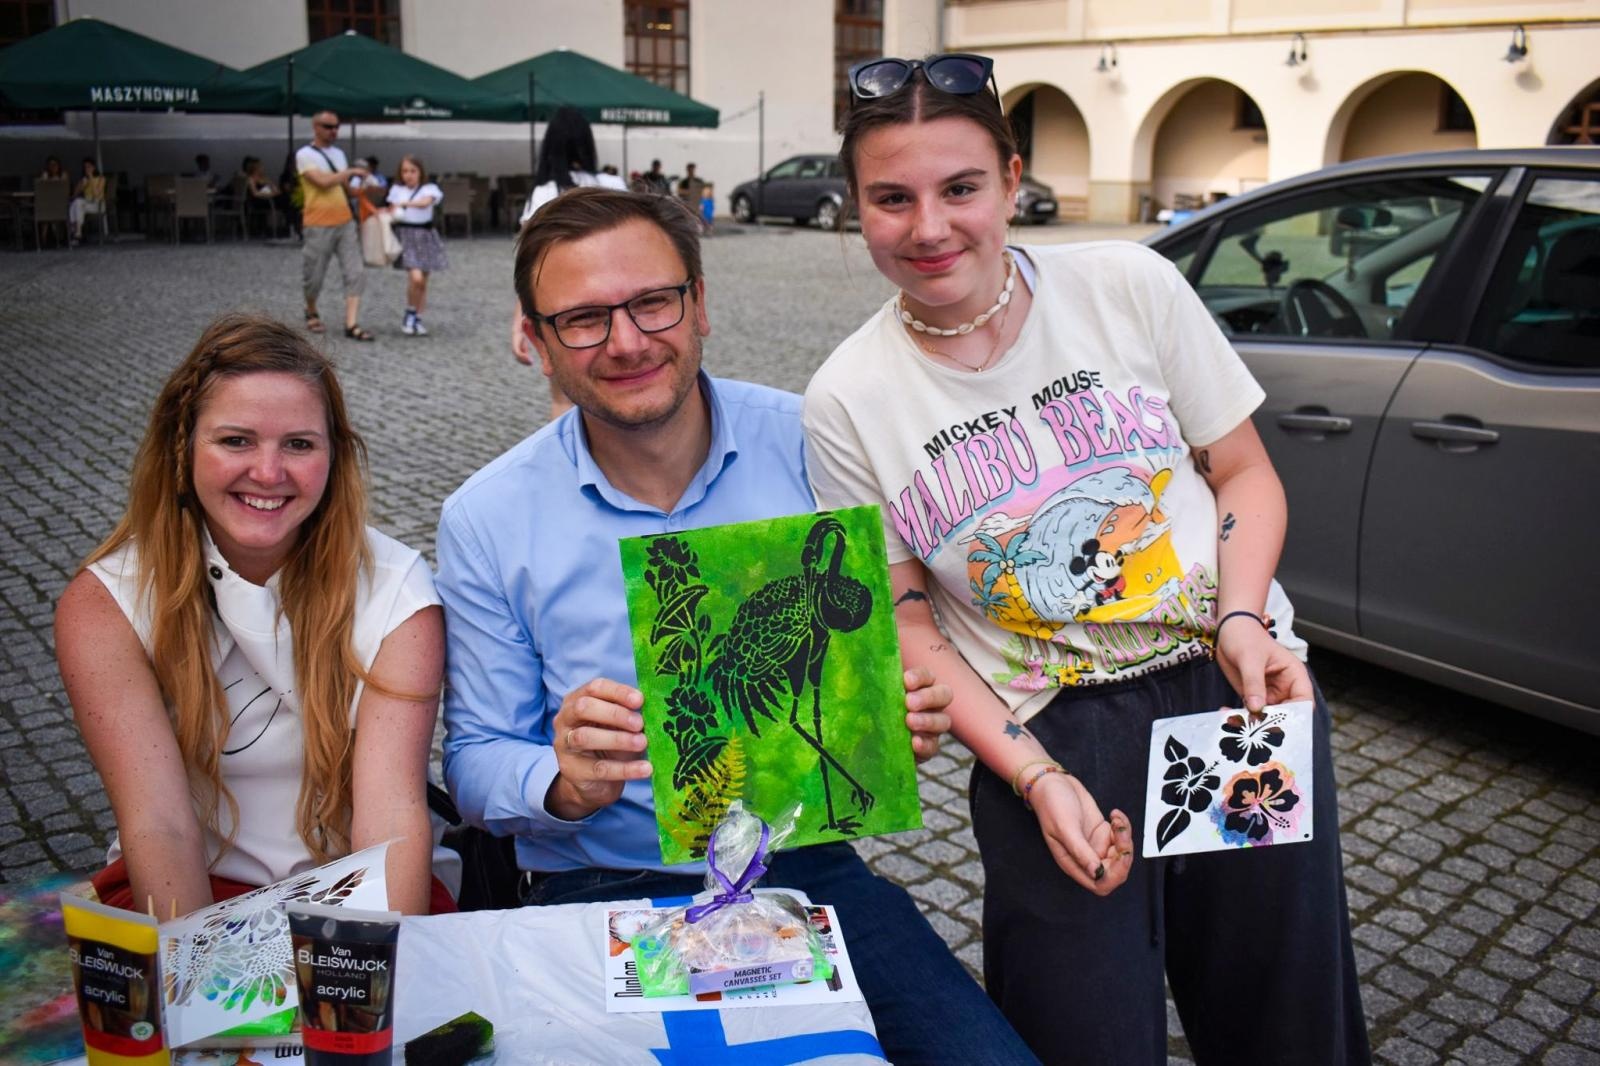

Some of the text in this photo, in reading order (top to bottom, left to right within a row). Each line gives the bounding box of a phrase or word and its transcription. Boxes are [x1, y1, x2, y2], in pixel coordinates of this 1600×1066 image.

[923, 369, 1104, 461] MICKEY MOUSE
[889, 416, 1039, 562] MALIBU
[96, 946, 115, 960] Van
[330, 945, 352, 957] Van
[69, 948, 144, 980] BLEISWIJCK
[298, 949, 387, 972] BLEISWIJCK
[316, 969, 367, 980] HOLLAND
[723, 972, 782, 988] CANVASSES SET
[734, 966, 772, 978] MAGNETIC
[84, 985, 126, 1004] acrylic
[316, 984, 367, 1000] acrylic
